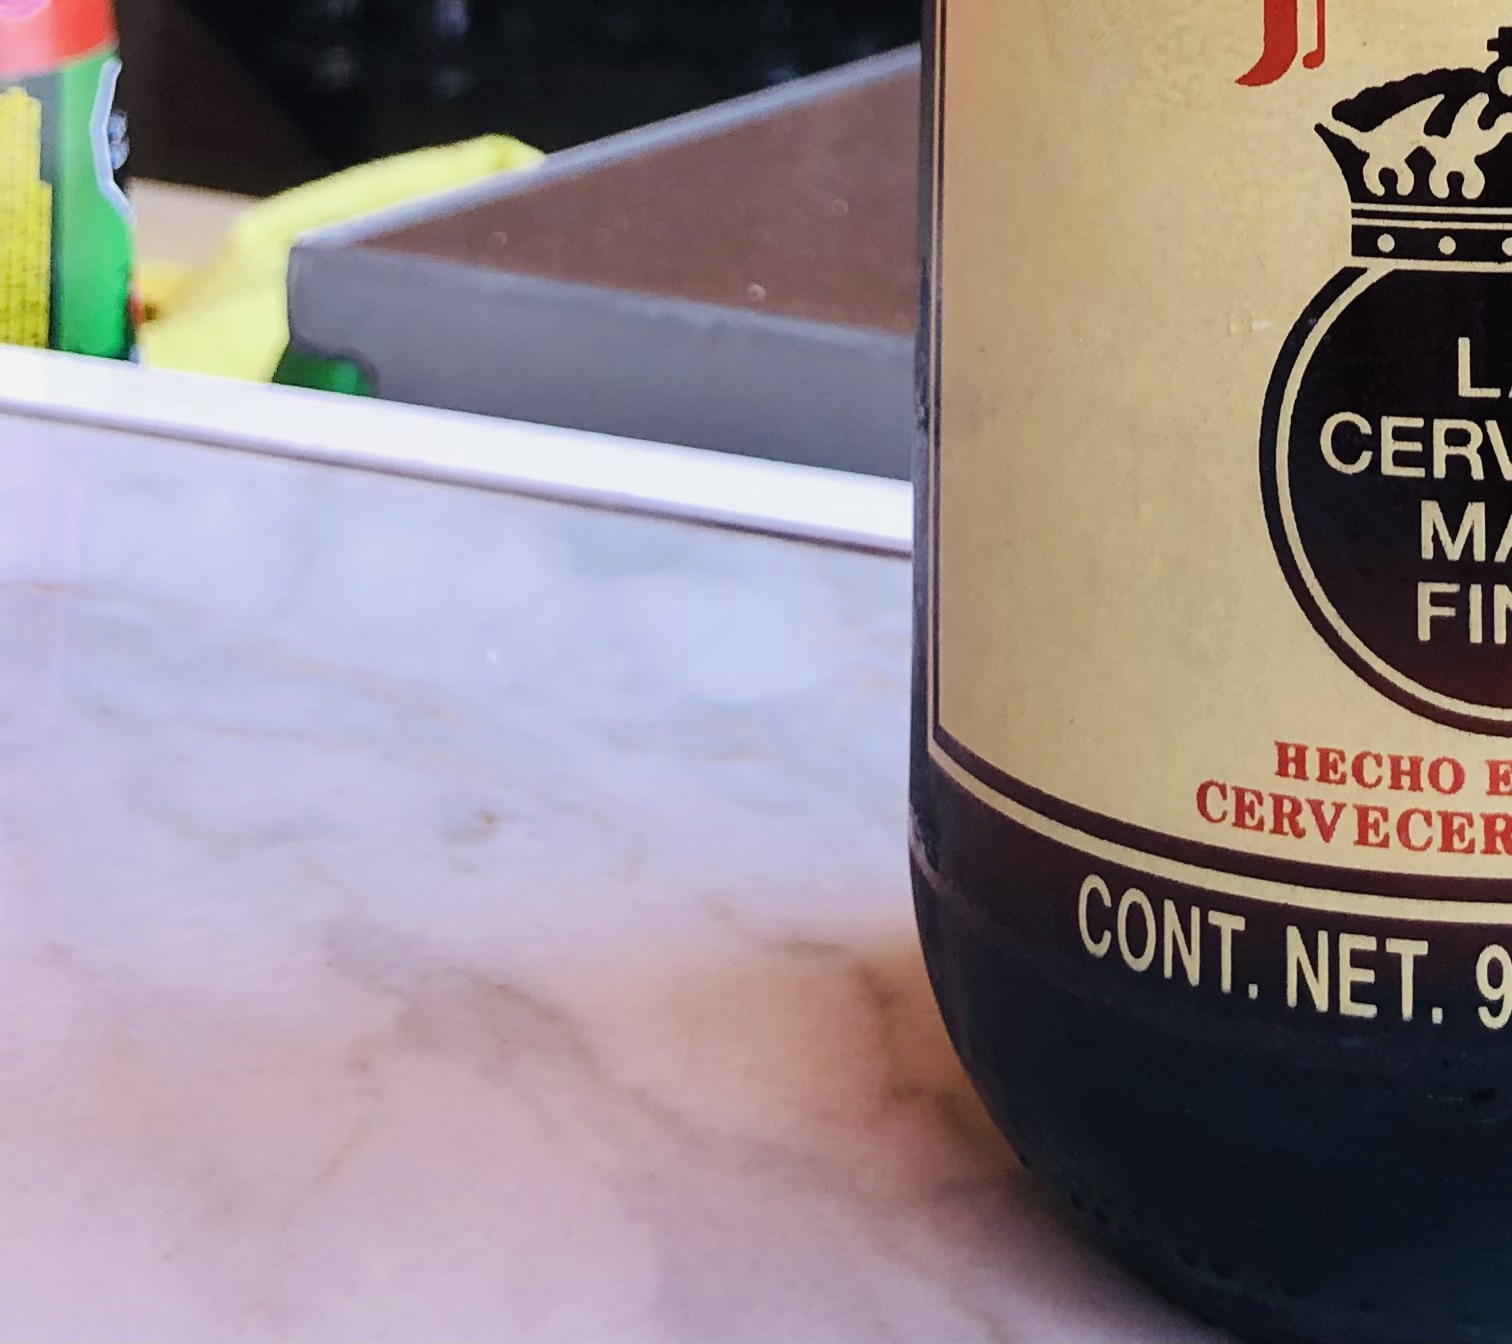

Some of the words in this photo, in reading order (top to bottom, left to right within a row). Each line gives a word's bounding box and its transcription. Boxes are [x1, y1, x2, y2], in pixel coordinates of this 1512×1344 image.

[1273, 739, 1467, 796] HECHO
[1077, 873, 1260, 1001] CONT.
[1285, 923, 1444, 1025] NET.
